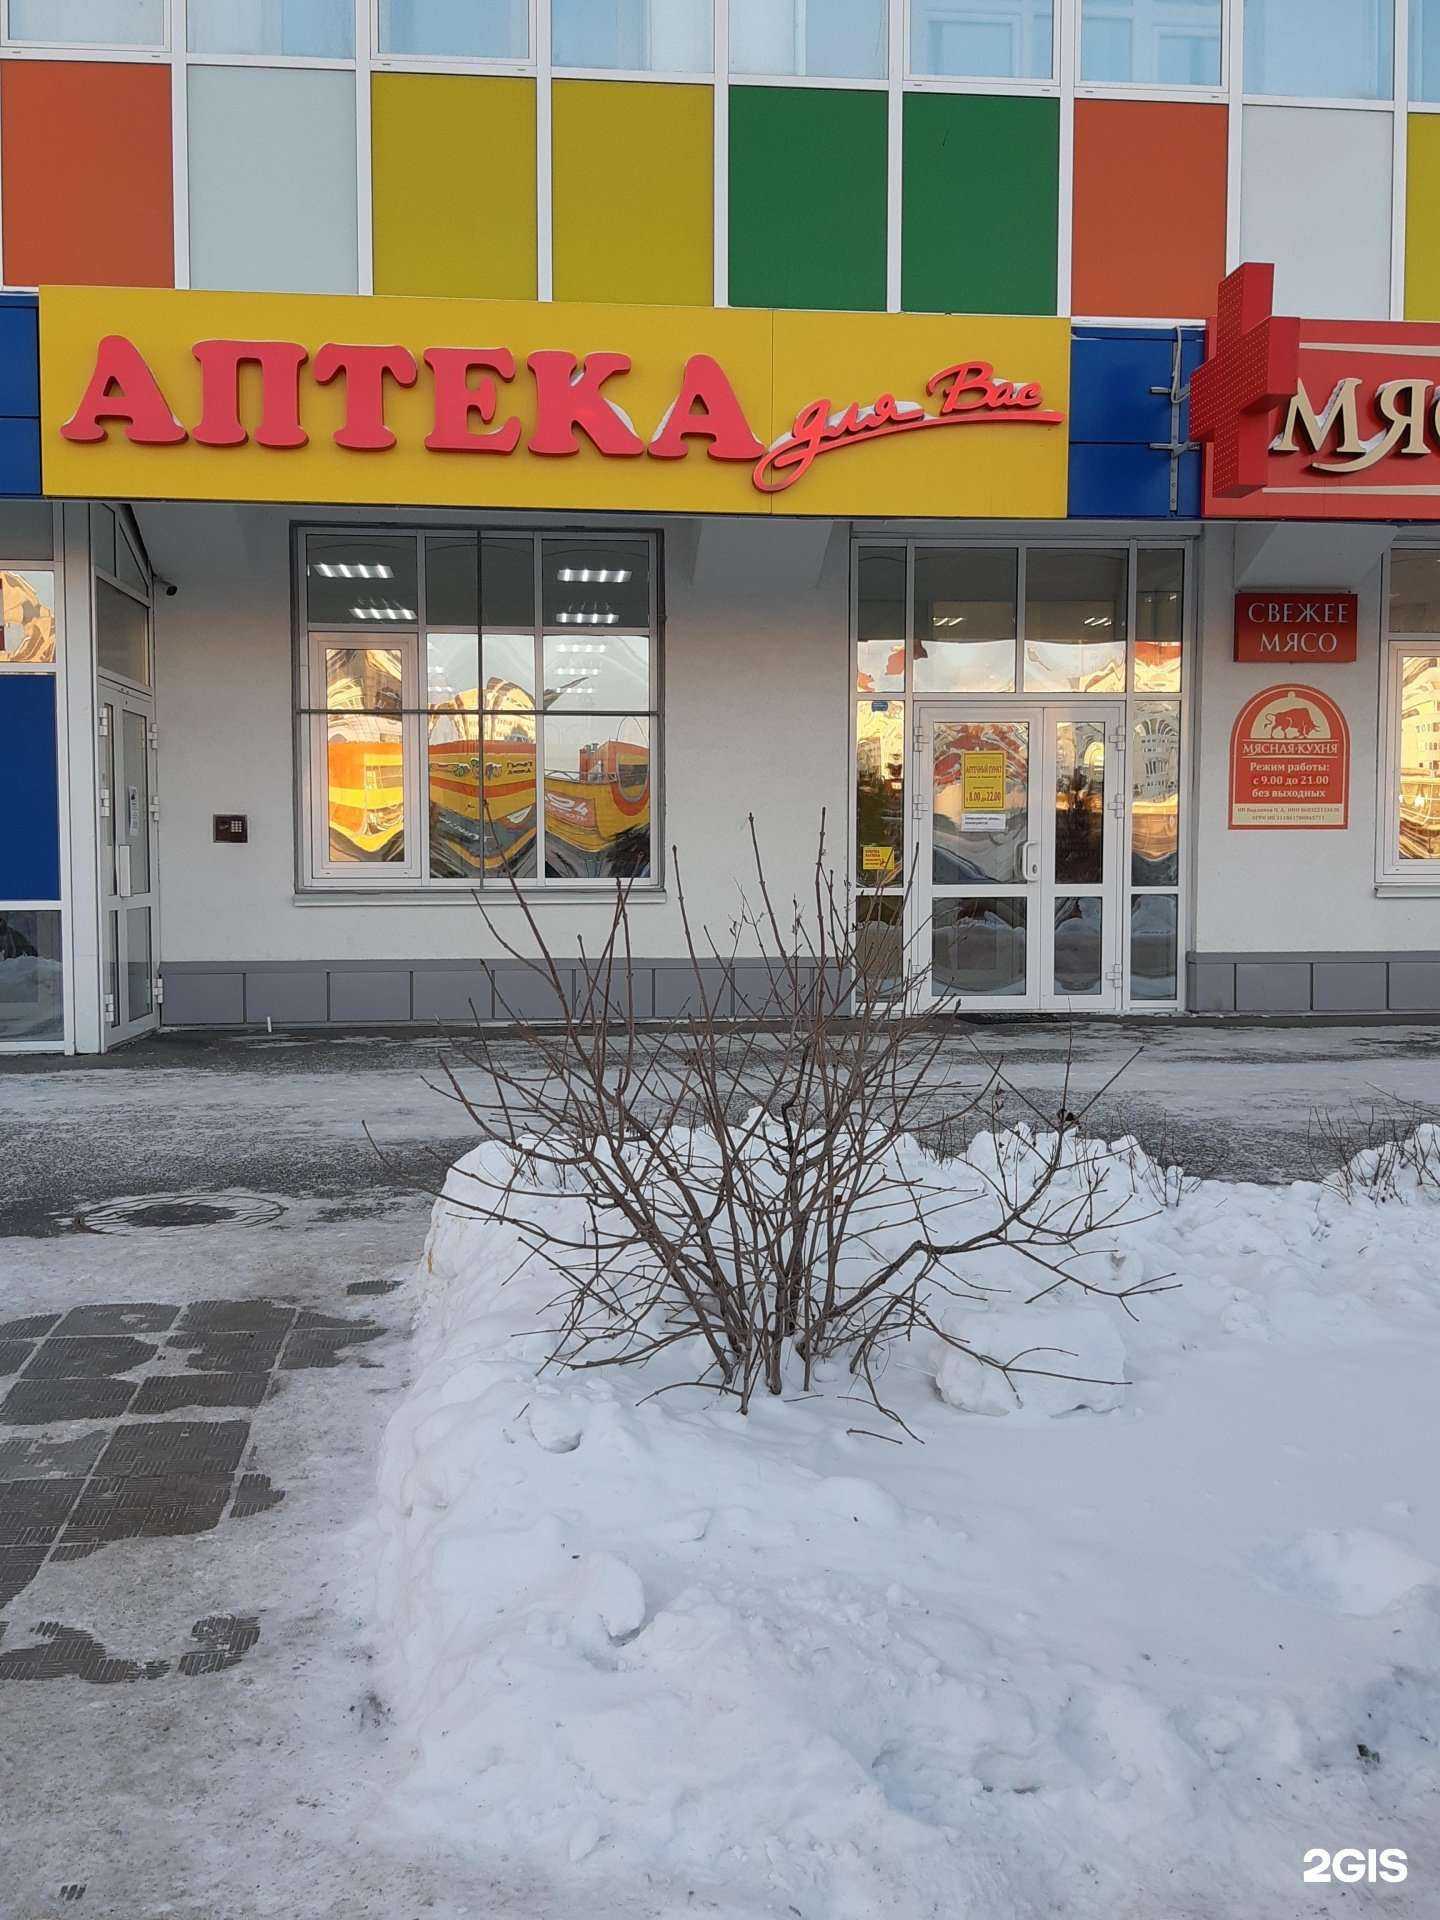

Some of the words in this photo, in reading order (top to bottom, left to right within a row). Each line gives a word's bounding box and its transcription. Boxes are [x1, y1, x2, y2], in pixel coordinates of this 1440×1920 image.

[60, 334, 766, 461] АПТЕКА
[926, 360, 1043, 416] Вас
[1270, 377, 1440, 473] МЯ
[1248, 602, 1350, 624] СВЕЖЕЕ
[1259, 632, 1338, 653] МЯСО
[1249, 762, 1286, 772] Режим
[1286, 762, 1331, 774] работы:
[1261, 775, 1284, 786] 9.00
[1284, 777, 1299, 787] до
[1300, 775, 1330, 786] 21.00
[1251, 789, 1271, 799] без
[1271, 789, 1327, 800] выходных
